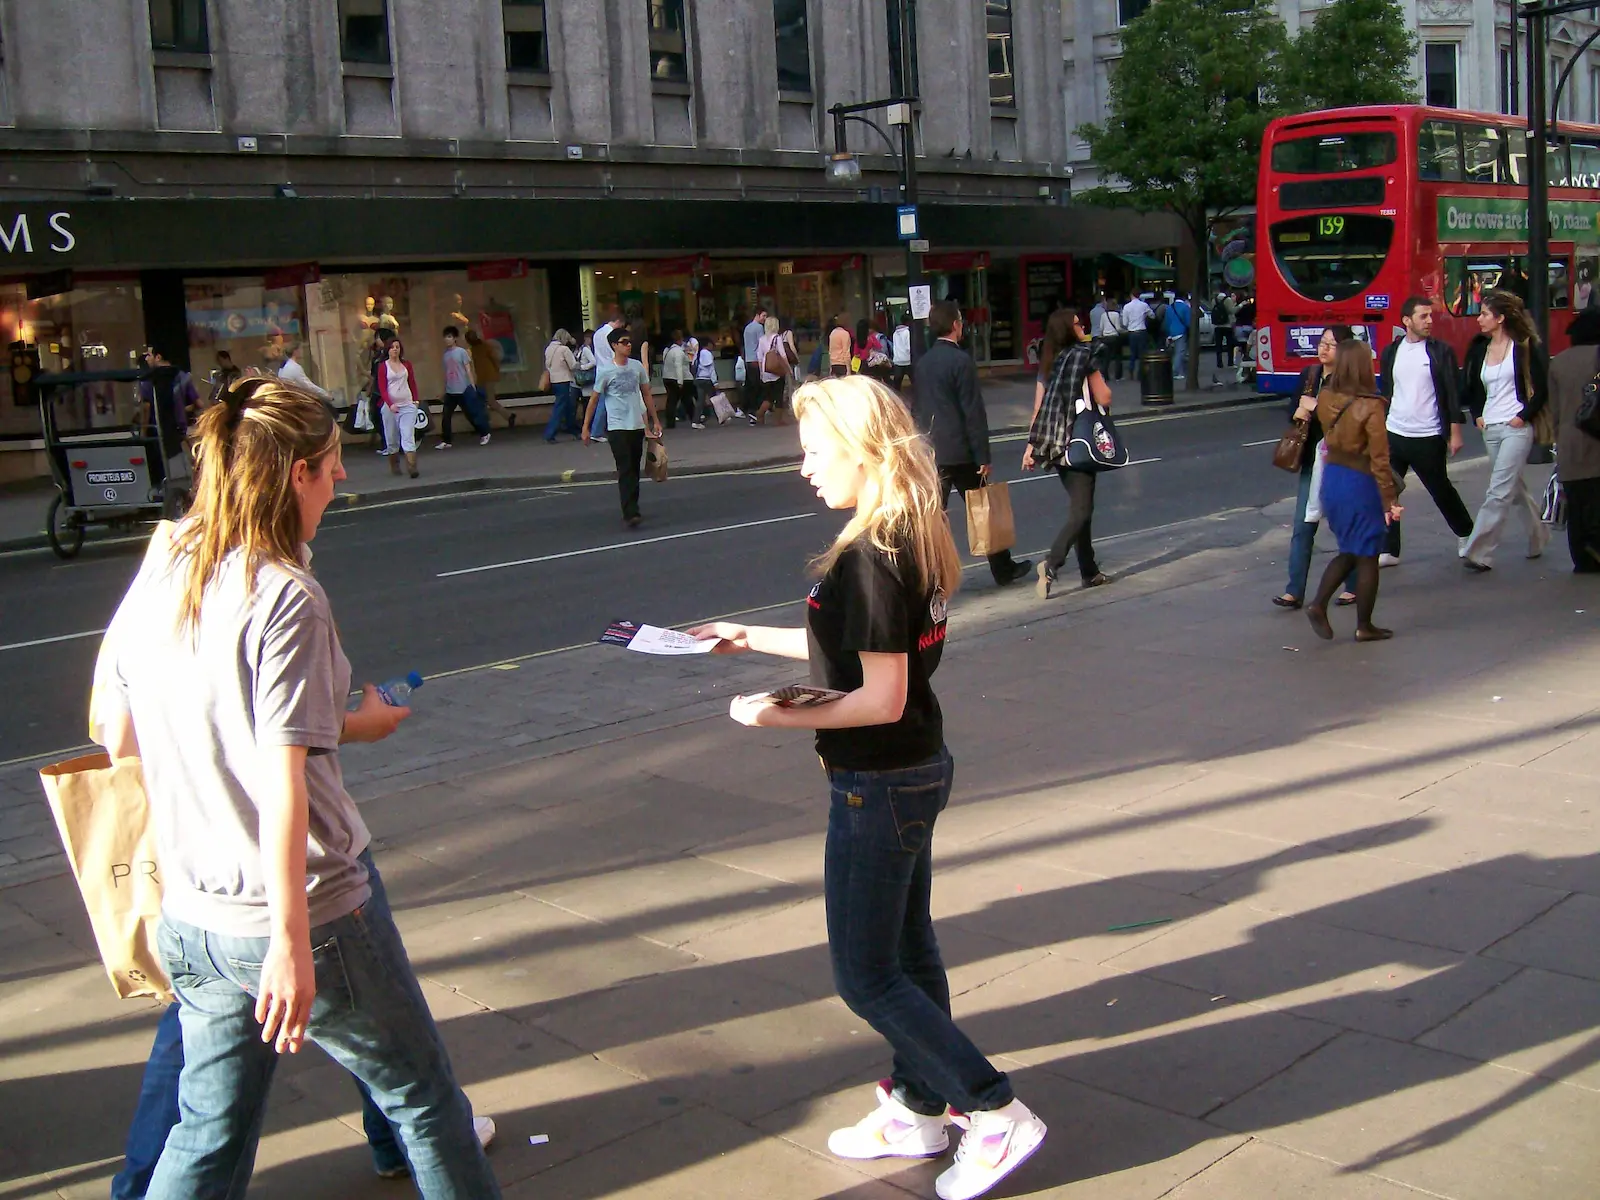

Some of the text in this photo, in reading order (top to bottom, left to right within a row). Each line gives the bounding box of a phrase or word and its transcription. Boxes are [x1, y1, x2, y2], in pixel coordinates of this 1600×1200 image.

[1447, 206, 1472, 229] Our
[1475, 210, 1503, 229] cows
[1505, 211, 1522, 230] are
[1320, 216, 1345, 235] 139
[120, 472, 134, 480] BIKE
[106, 490, 115, 499] 42
